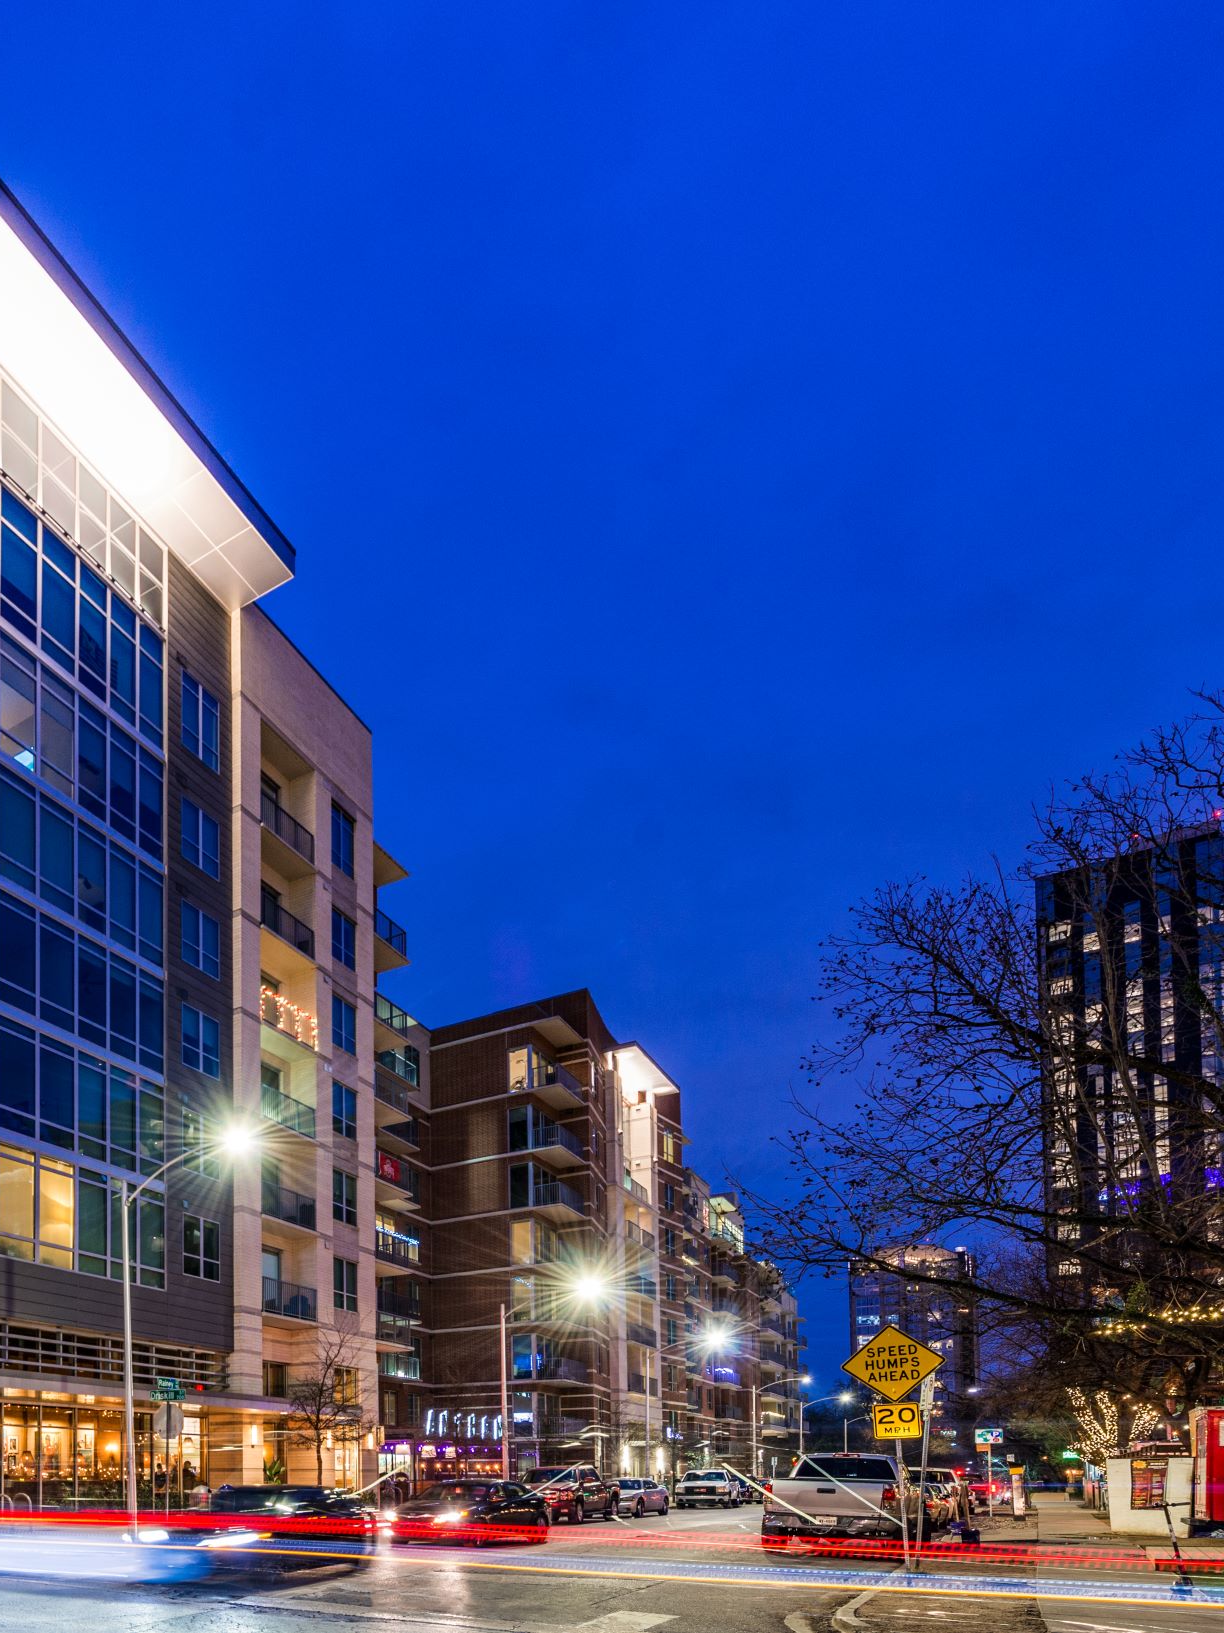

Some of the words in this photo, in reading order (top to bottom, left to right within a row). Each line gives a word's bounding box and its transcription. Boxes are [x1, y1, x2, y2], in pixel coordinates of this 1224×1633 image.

[866, 1344, 918, 1359] SPEED
[865, 1356, 920, 1371] HUMPS
[867, 1369, 921, 1383] AHEAD
[158, 1379, 174, 1389] Rainey
[150, 1390, 175, 1400] Driskill
[877, 1407, 916, 1425] 20
[884, 1426, 911, 1434] MPH
